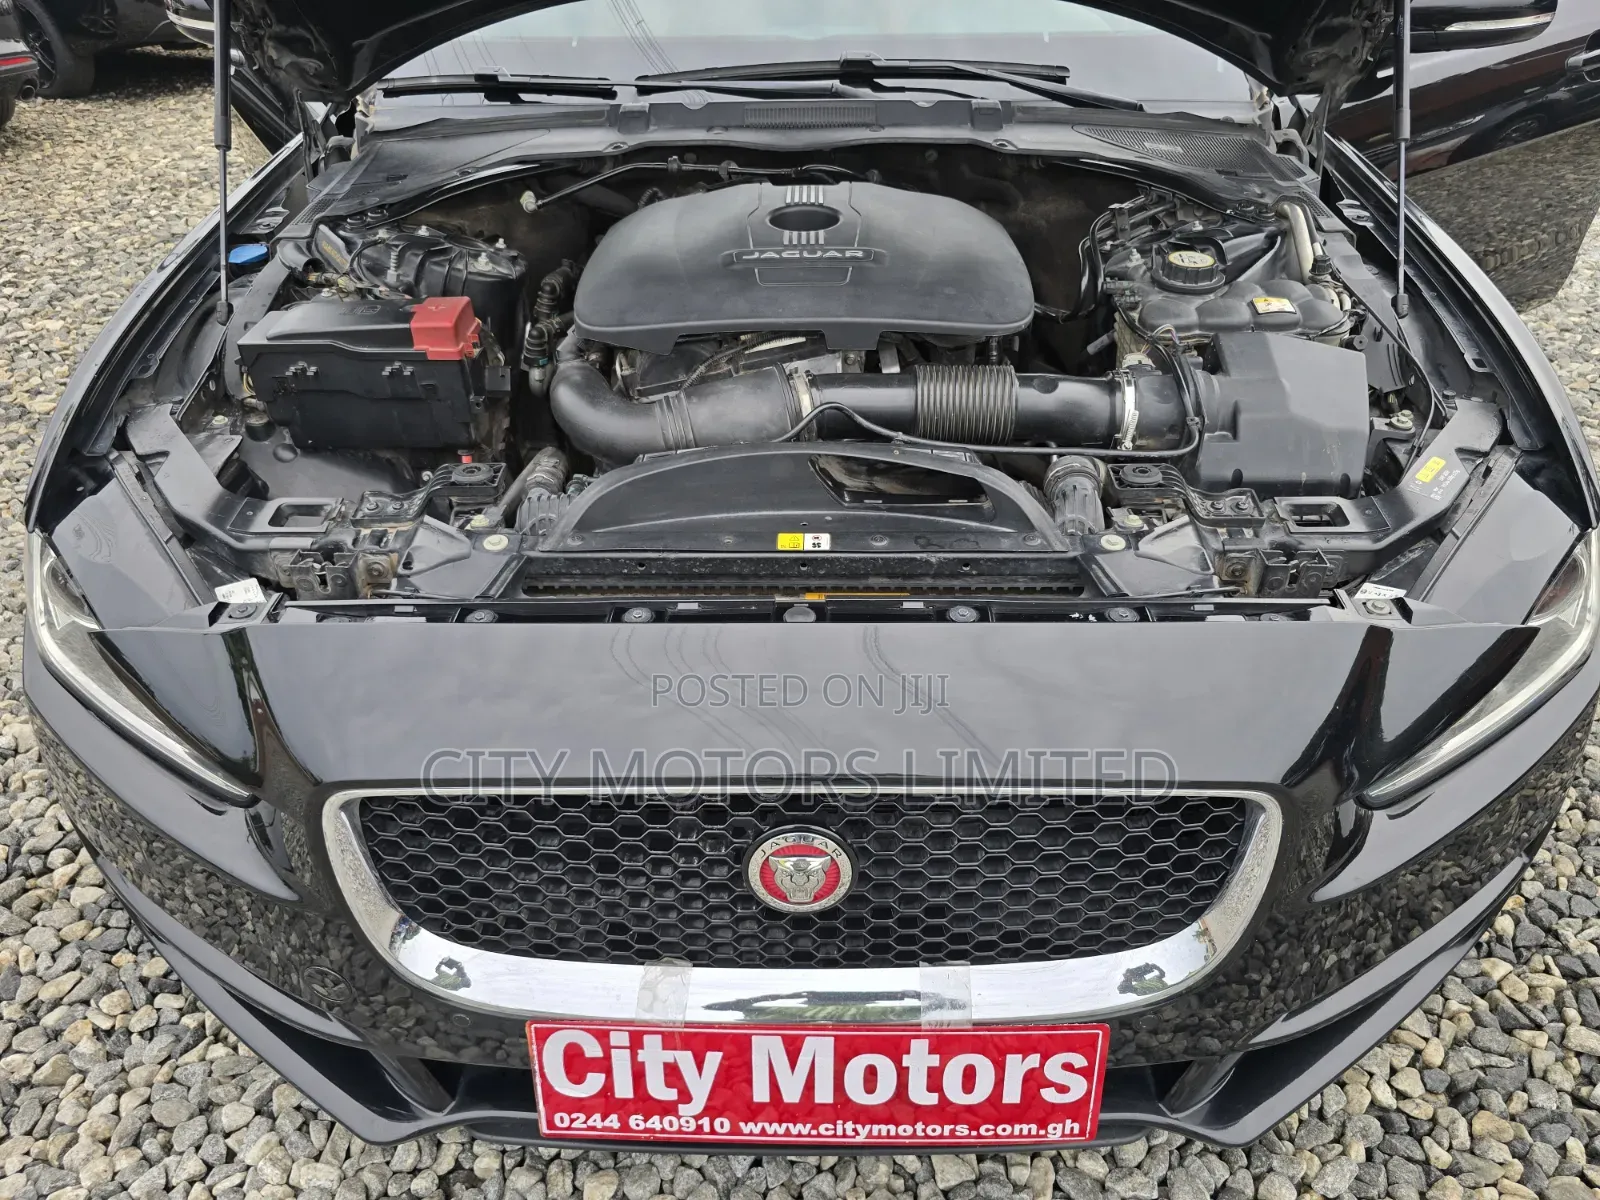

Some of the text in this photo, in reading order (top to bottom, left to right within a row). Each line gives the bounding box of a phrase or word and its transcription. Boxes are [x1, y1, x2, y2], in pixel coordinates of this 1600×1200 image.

[742, 250, 864, 260] JAGUAR
[760, 834, 843, 859] JAGUAR
[542, 1029, 1089, 1117] City Motors
[553, 1111, 1080, 1140] 0244 640910 www.citymotors.com.gh
